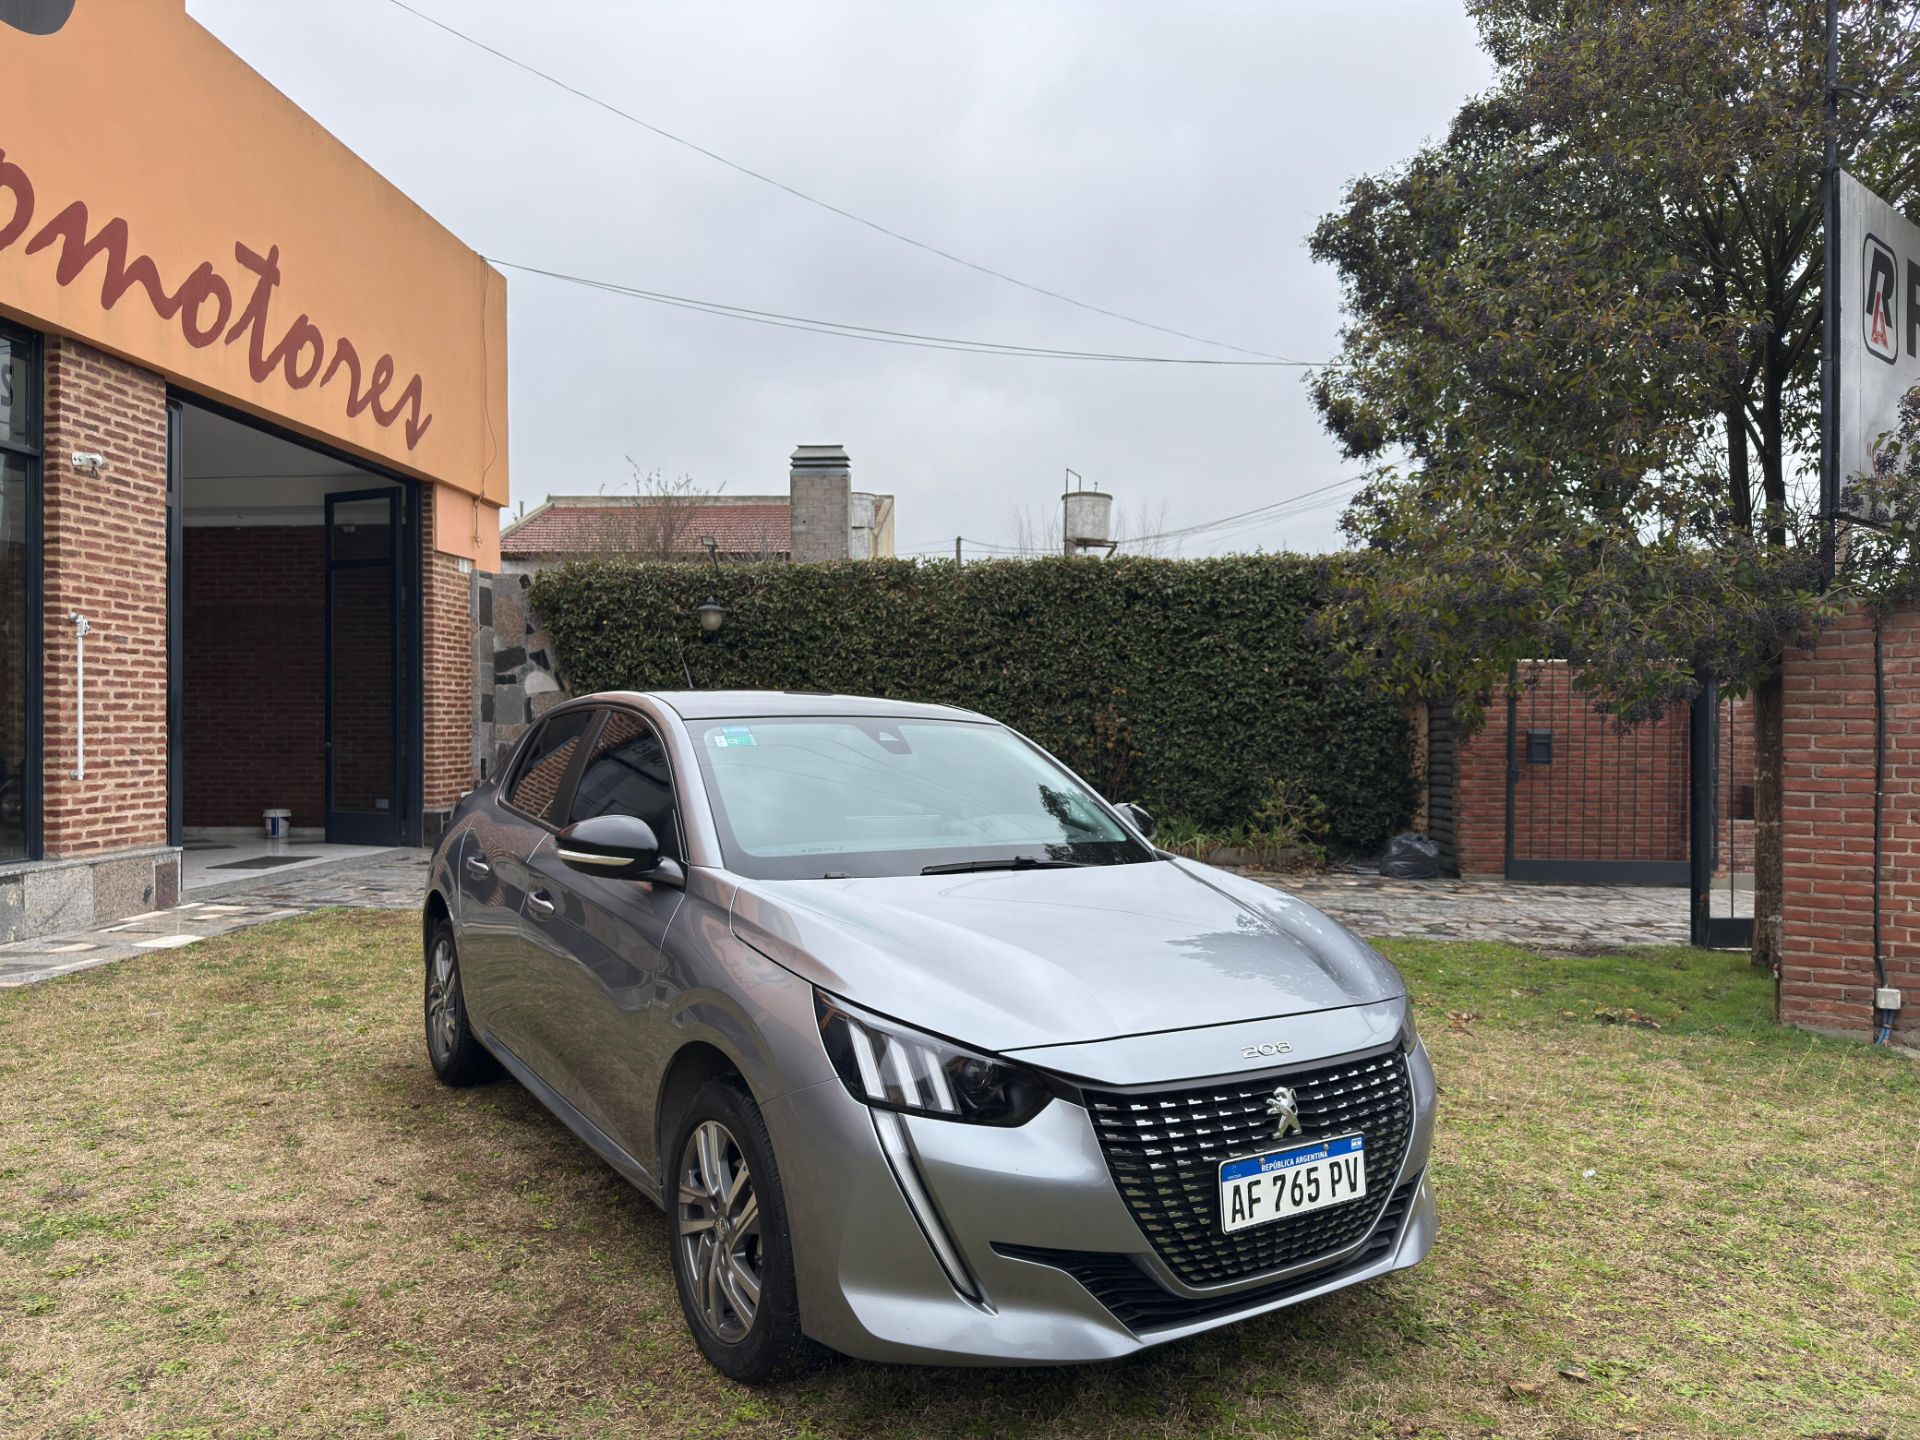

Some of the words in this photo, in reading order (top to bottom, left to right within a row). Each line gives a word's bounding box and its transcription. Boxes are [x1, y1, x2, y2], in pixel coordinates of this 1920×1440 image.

[1241, 1041, 1293, 1059] 208
[1261, 1159, 1294, 1172] REPÚBLICA
[1295, 1150, 1328, 1164] ARGENTINA
[1231, 1179, 1262, 1224] AF
[1272, 1166, 1320, 1212] 765
[1329, 1156, 1358, 1197] PV
